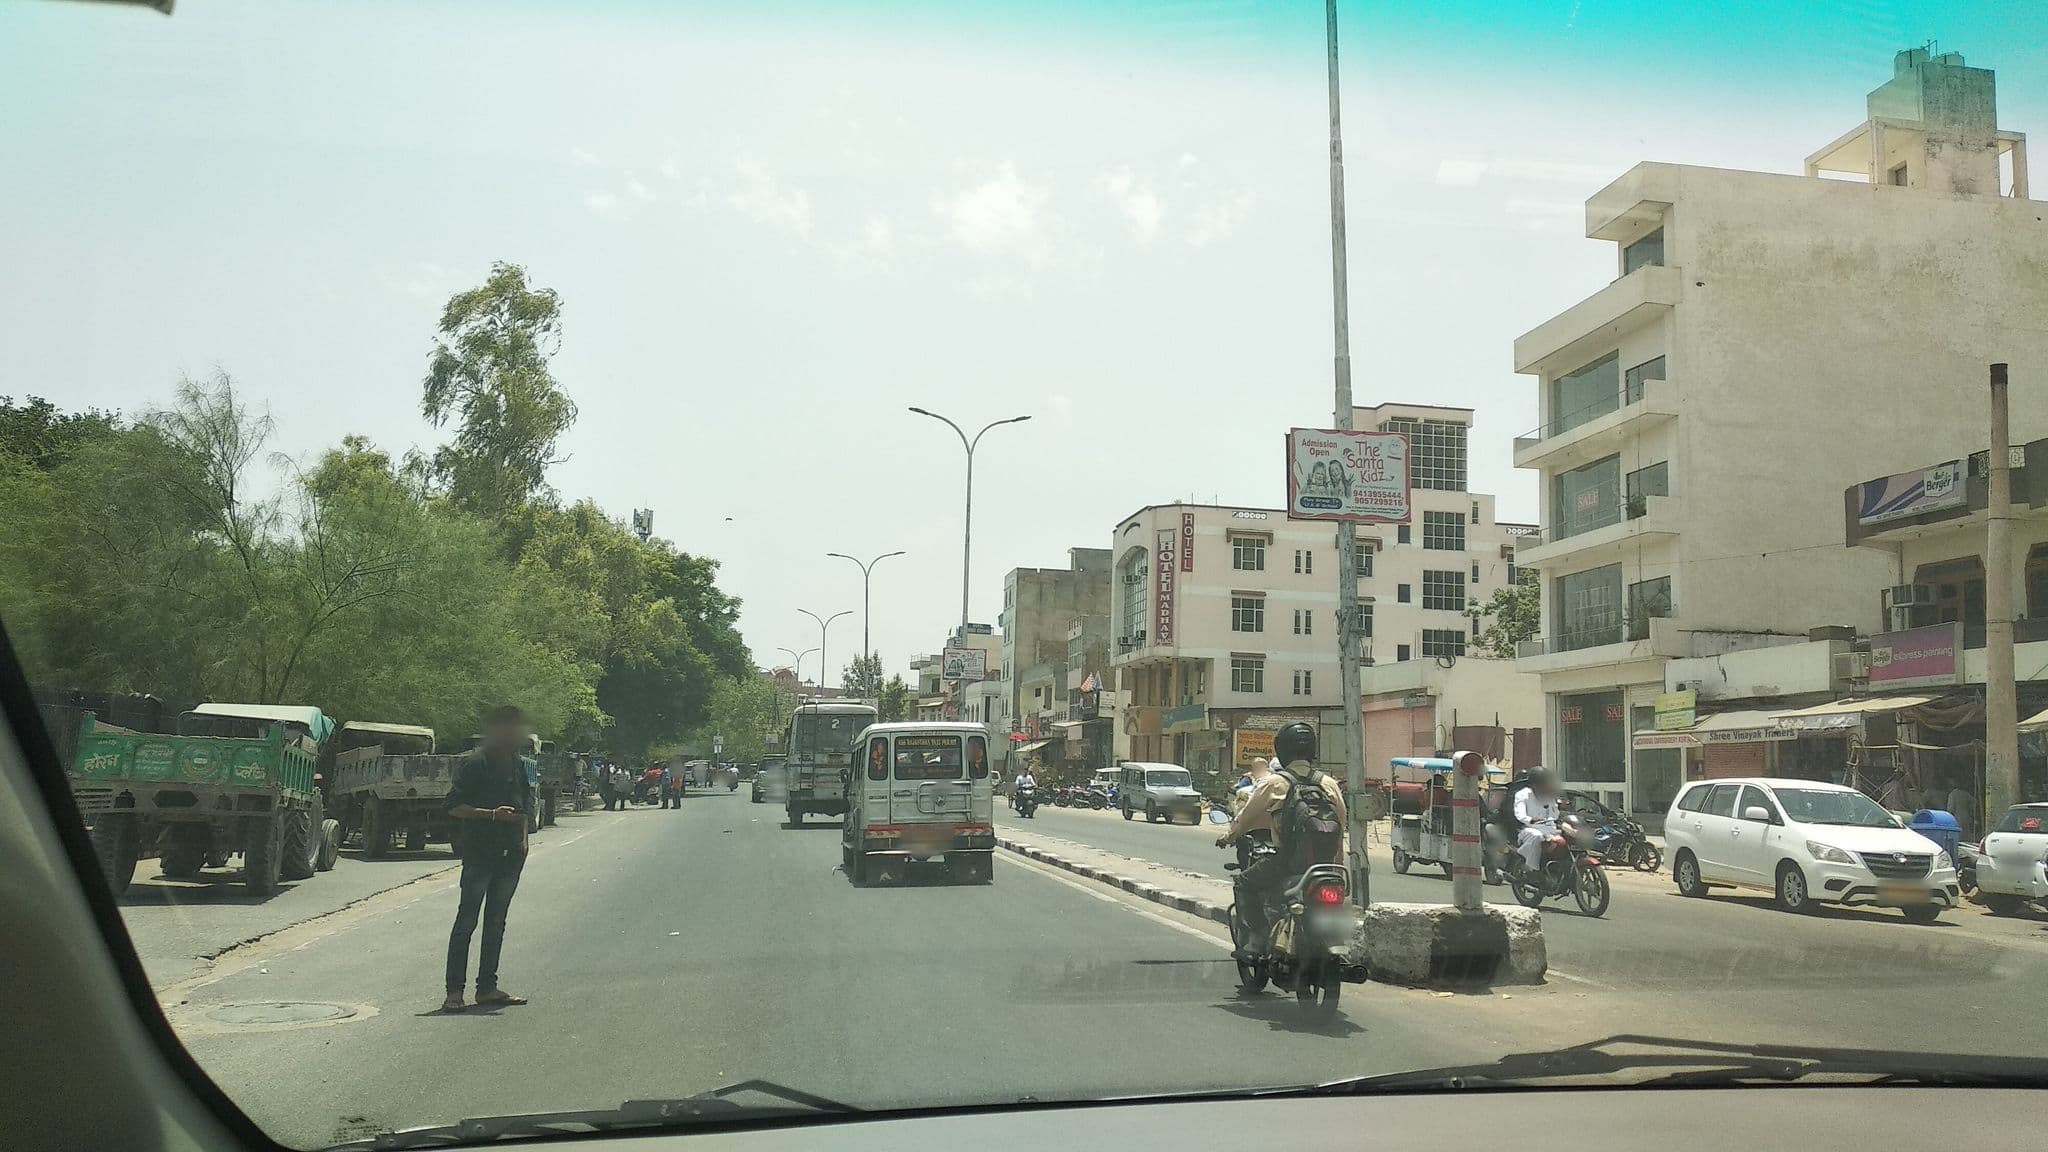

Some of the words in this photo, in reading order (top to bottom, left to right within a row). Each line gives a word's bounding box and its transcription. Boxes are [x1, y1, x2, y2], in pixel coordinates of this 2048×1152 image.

[1302, 438, 1338, 448] Admission
[1355, 440, 1381, 457] The
[1309, 447, 1330, 457] Open
[1346, 454, 1384, 470] Santa
[1360, 469, 1386, 484] Kidz
[1926, 479, 1952, 492] Berger
[1184, 514, 1193, 570] HOTEL
[1159, 541, 1174, 592] HOTEL
[1160, 594, 1171, 639] MADHAV
[1924, 647, 1953, 660] painting
[1561, 706, 1582, 722] SALE
[831, 718, 841, 729] 2
[1709, 730, 1731, 741] Shree
[1733, 730, 1762, 741] Vinayak
[1242, 746, 1273, 756] Ambuja
